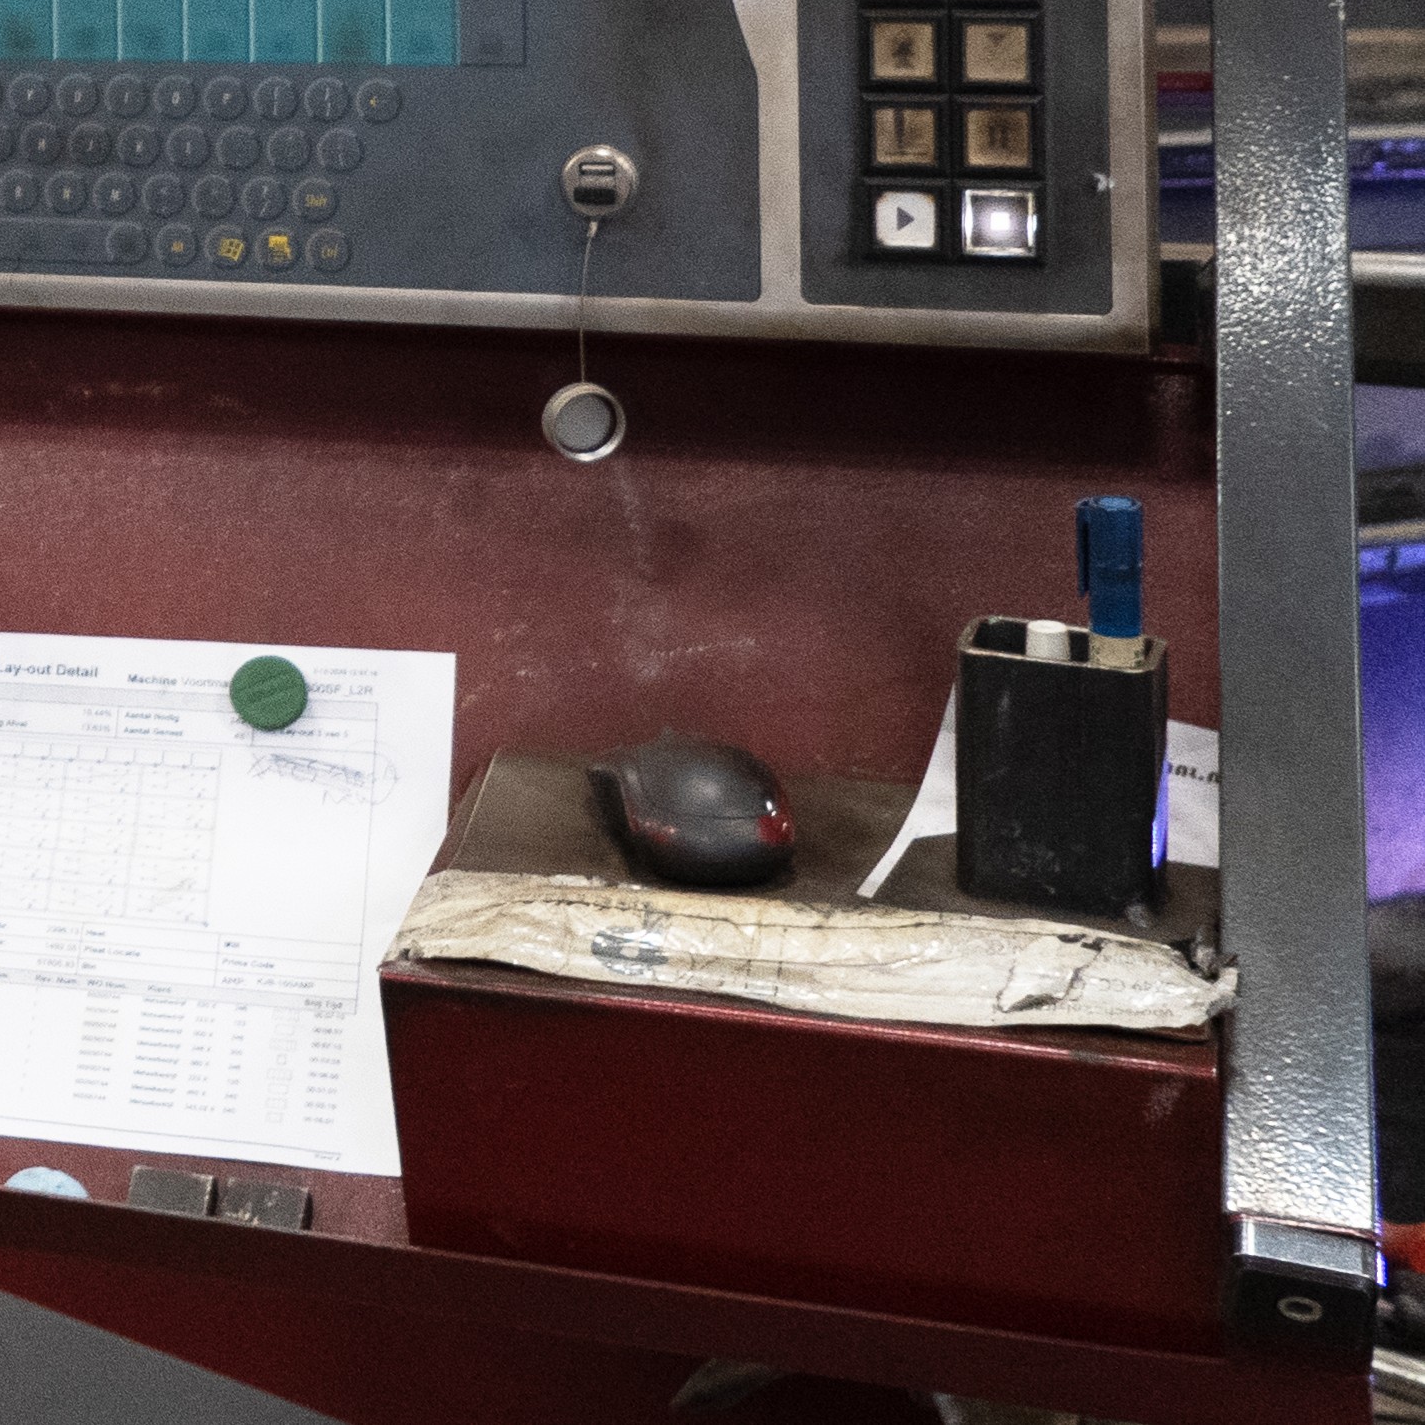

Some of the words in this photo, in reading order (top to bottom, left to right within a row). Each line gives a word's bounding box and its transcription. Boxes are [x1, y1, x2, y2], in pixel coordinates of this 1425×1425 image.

[55, 663, 100, 678] Detail
[127, 673, 177, 687] Machine
[181, 677, 230, 689] Voortma
